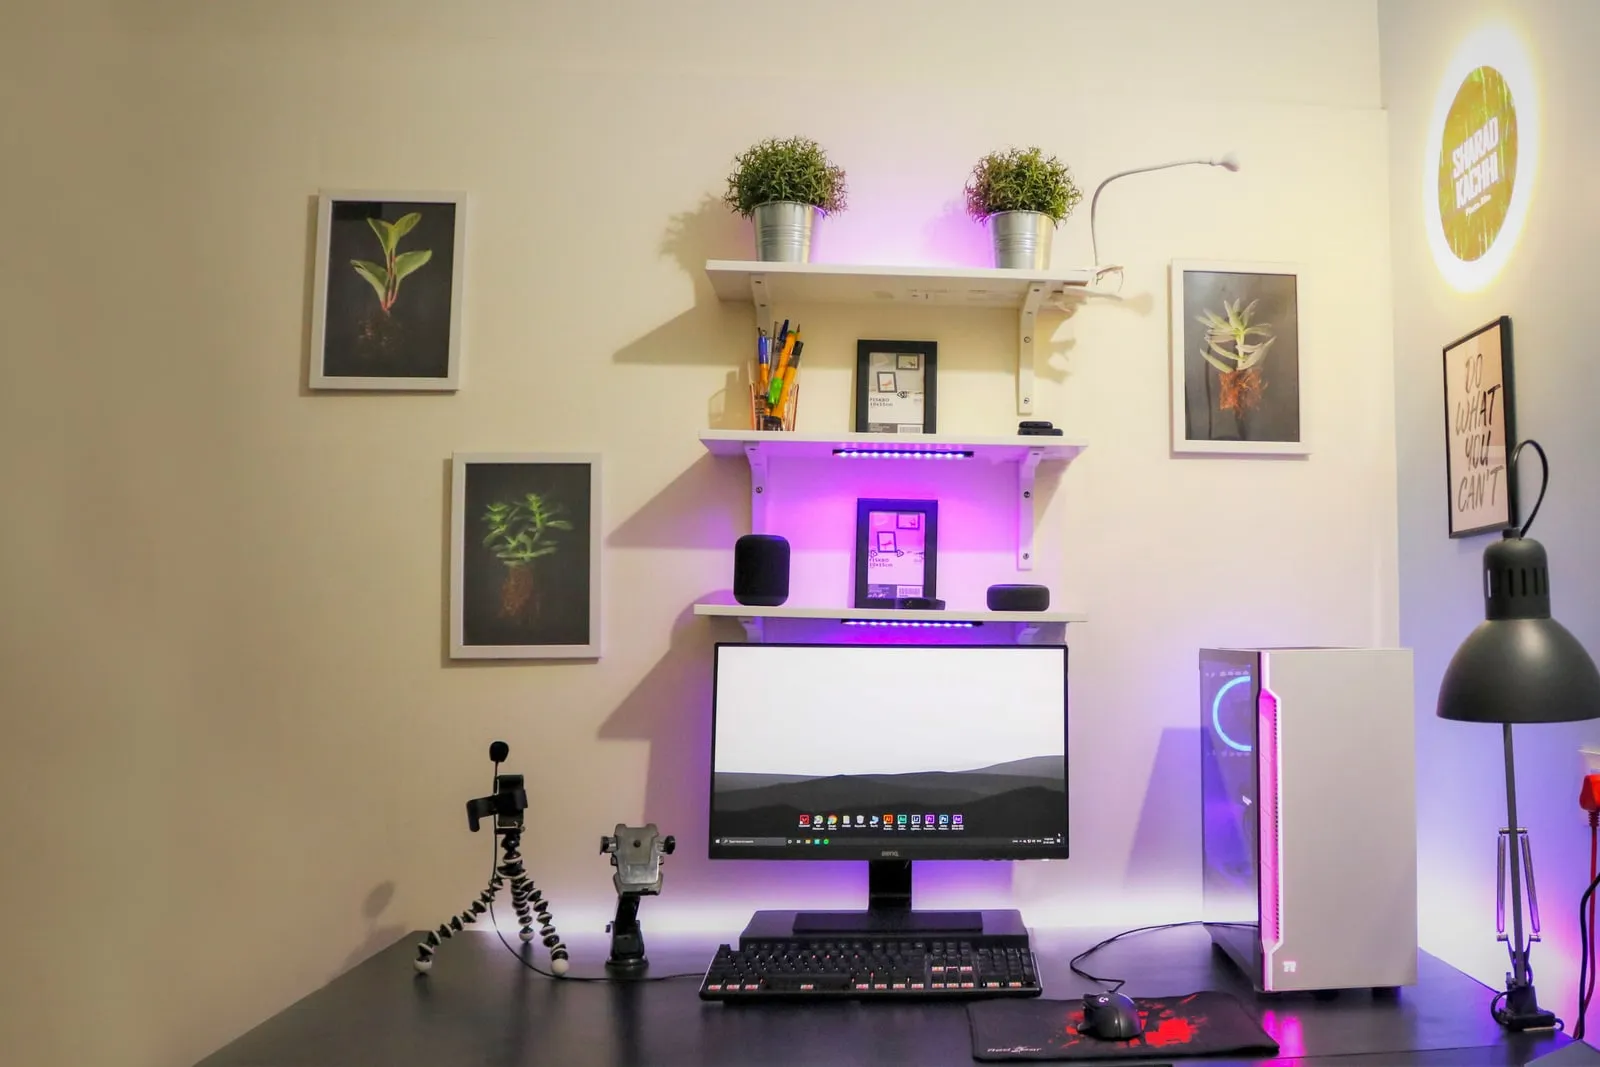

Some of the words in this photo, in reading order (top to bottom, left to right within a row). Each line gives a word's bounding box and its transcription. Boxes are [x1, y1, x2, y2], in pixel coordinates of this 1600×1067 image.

[1452, 115, 1499, 179] SHARAD
[1465, 353, 1484, 394] DO
[1455, 383, 1502, 437] WHAT
[1465, 430, 1492, 472] YOU
[1457, 465, 1504, 513] CAN'T
